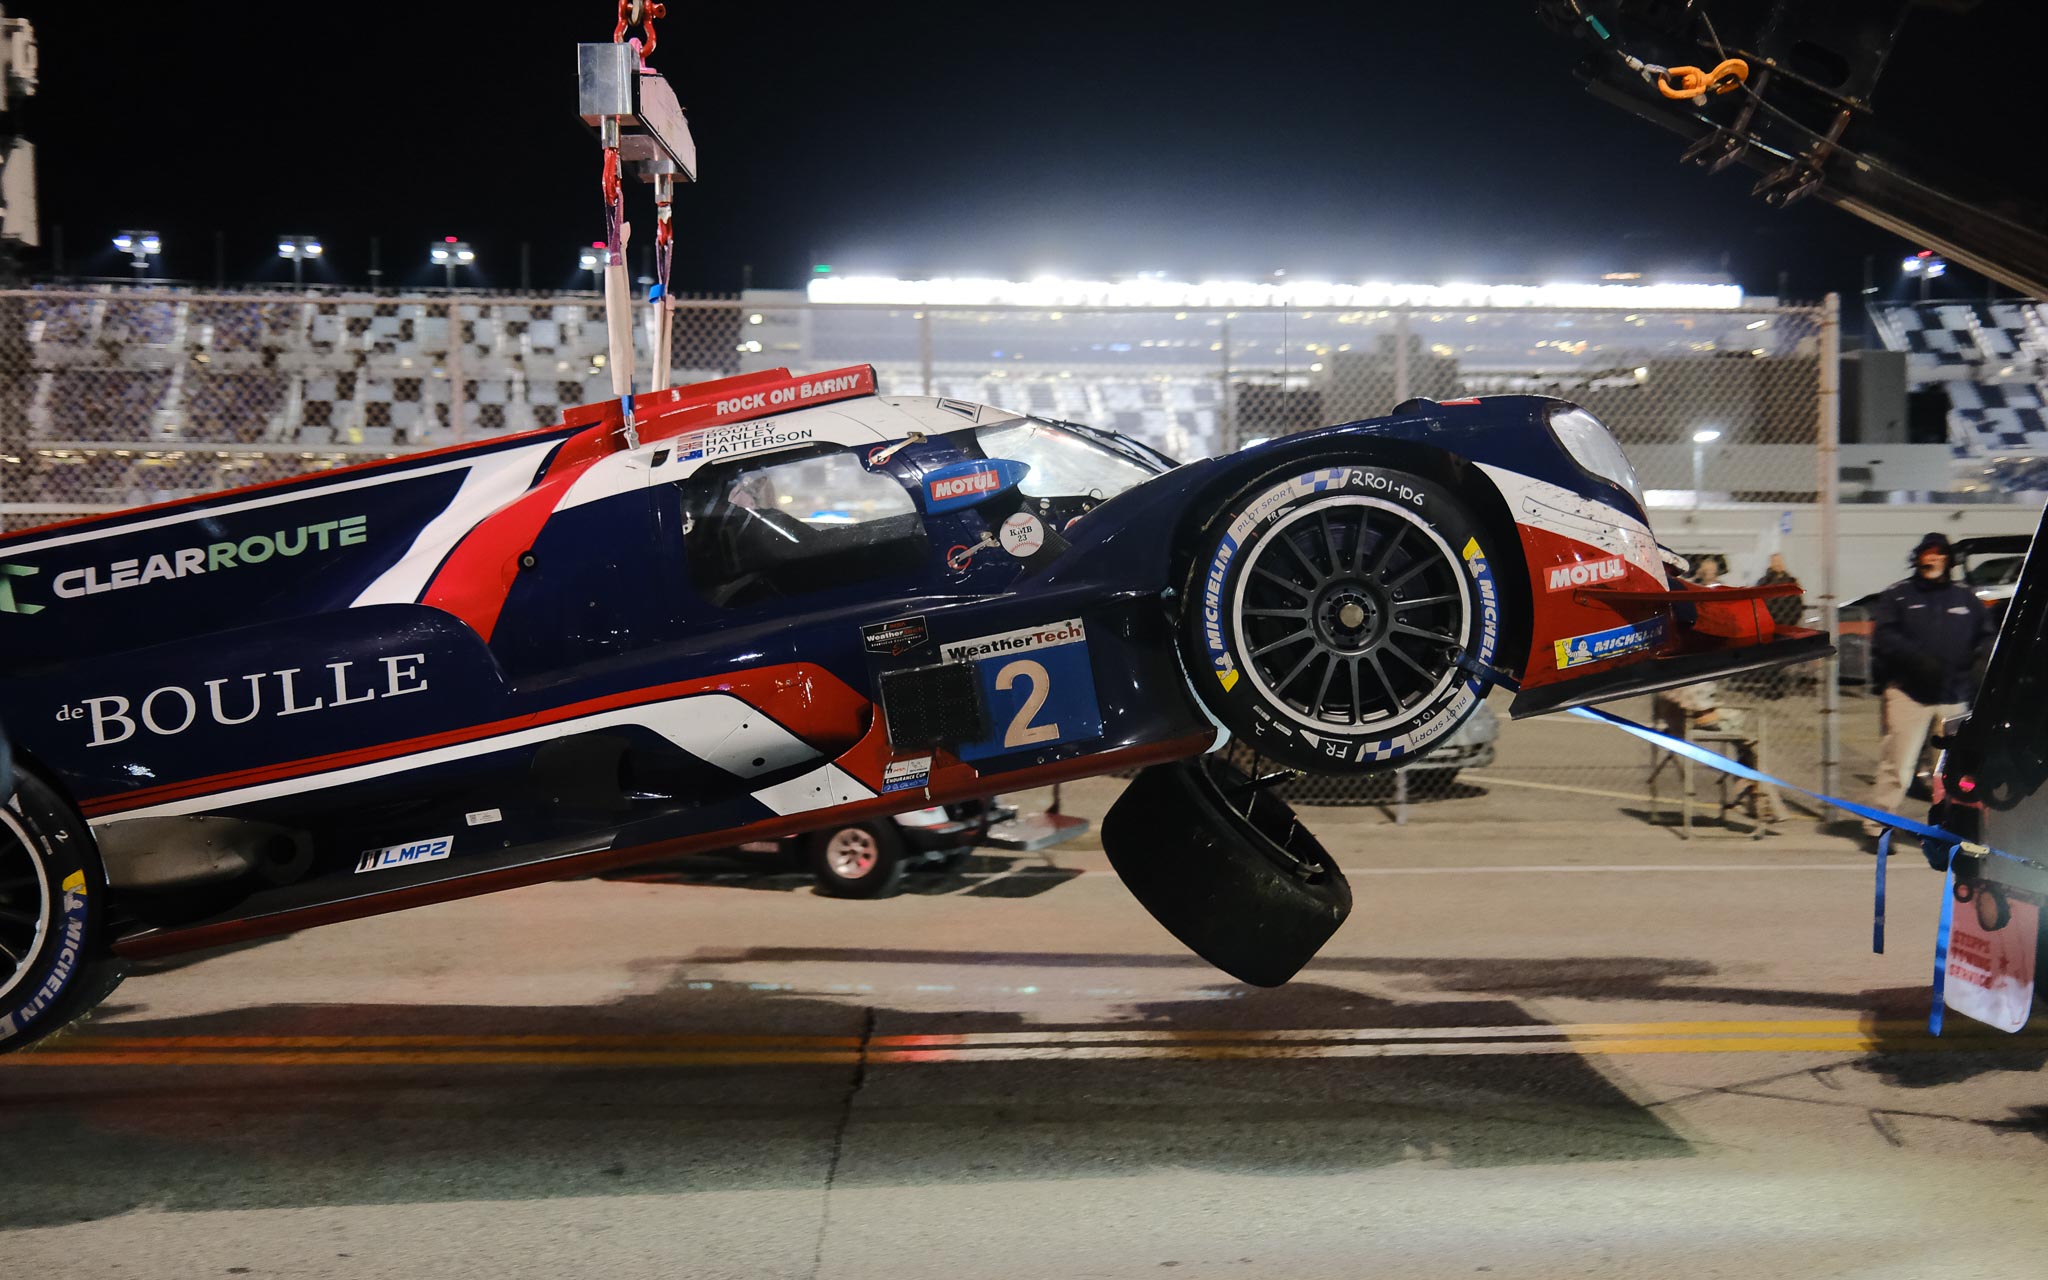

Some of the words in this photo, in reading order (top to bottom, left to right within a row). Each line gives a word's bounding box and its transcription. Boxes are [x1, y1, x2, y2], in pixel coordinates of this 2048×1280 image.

[716, 394, 766, 416] ROCK
[769, 386, 796, 405] ON
[800, 373, 861, 399] BARNY
[705, 427, 776, 447] HANLEY
[706, 429, 813, 457] PATTERSON
[935, 473, 997, 498] MOTUL
[1237, 508, 1261, 533] PILOT
[1262, 487, 1294, 510] SPORT
[1009, 525, 1033, 537] KMB
[52, 514, 367, 599] CLEARROUTE
[1549, 558, 1625, 590] MOTUL
[1205, 543, 1233, 650] MICHELIN
[947, 626, 1082, 661] WeatherTech
[995, 659, 1060, 748] 2
[1446, 696, 1467, 723] PILOT
[1413, 720, 1444, 743] SPORT
[382, 840, 448, 865] LMP2
[20, 916, 83, 1023] MICHELIN
